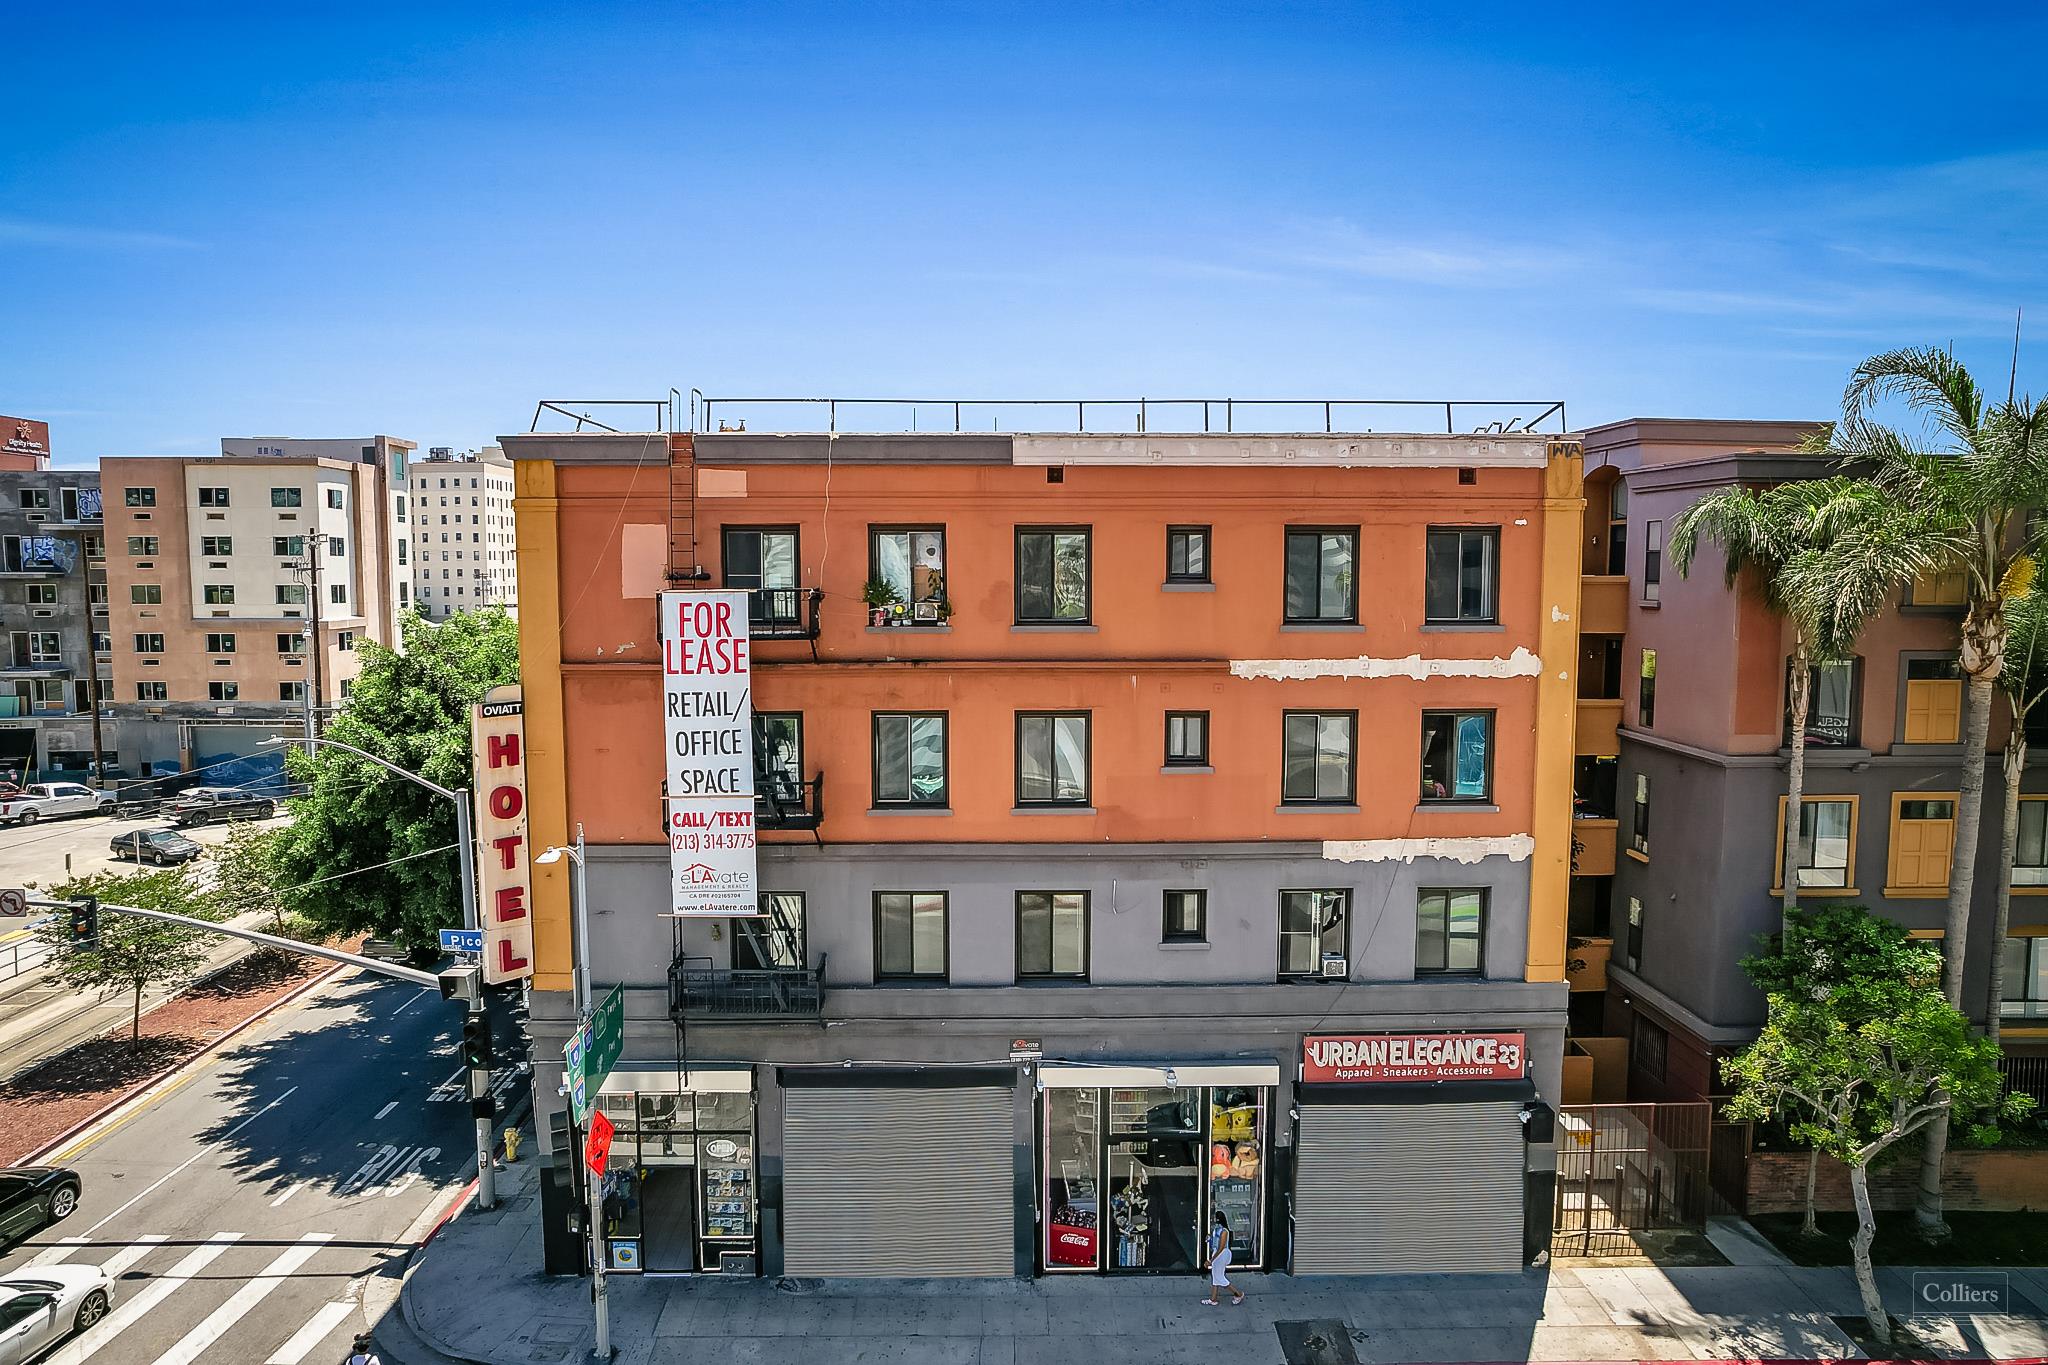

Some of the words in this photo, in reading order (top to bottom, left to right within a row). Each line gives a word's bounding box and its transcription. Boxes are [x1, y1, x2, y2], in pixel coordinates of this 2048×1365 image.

[679, 602, 732, 638] FOR
[666, 639, 747, 674] LEASE
[483, 703, 521, 716] OVIATT
[668, 688, 748, 722] RETAIL/
[675, 729, 742, 756] OFFICE
[680, 768, 740, 793] SPACE
[672, 811, 753, 831] CALL/TEXT
[487, 733, 528, 973] HOTEL
[672, 833, 700, 853] (213)
[703, 834, 754, 849] 314-3775
[681, 869, 749, 884] eLAvate
[677, 903, 756, 911] www.eLAvatere.com
[450, 935, 482, 947] Pico
[1306, 1041, 1388, 1067] URBAN
[1389, 1038, 1497, 1066] ELEGANCE
[1498, 1044, 1520, 1070] 23
[1335, 1067, 1373, 1079] Apparel
[1383, 1067, 1428, 1077] Sneakers
[1436, 1065, 1494, 1076] Accessories
[710, 1143, 734, 1153] OPEN
[334, 1144, 442, 1197] BUS
